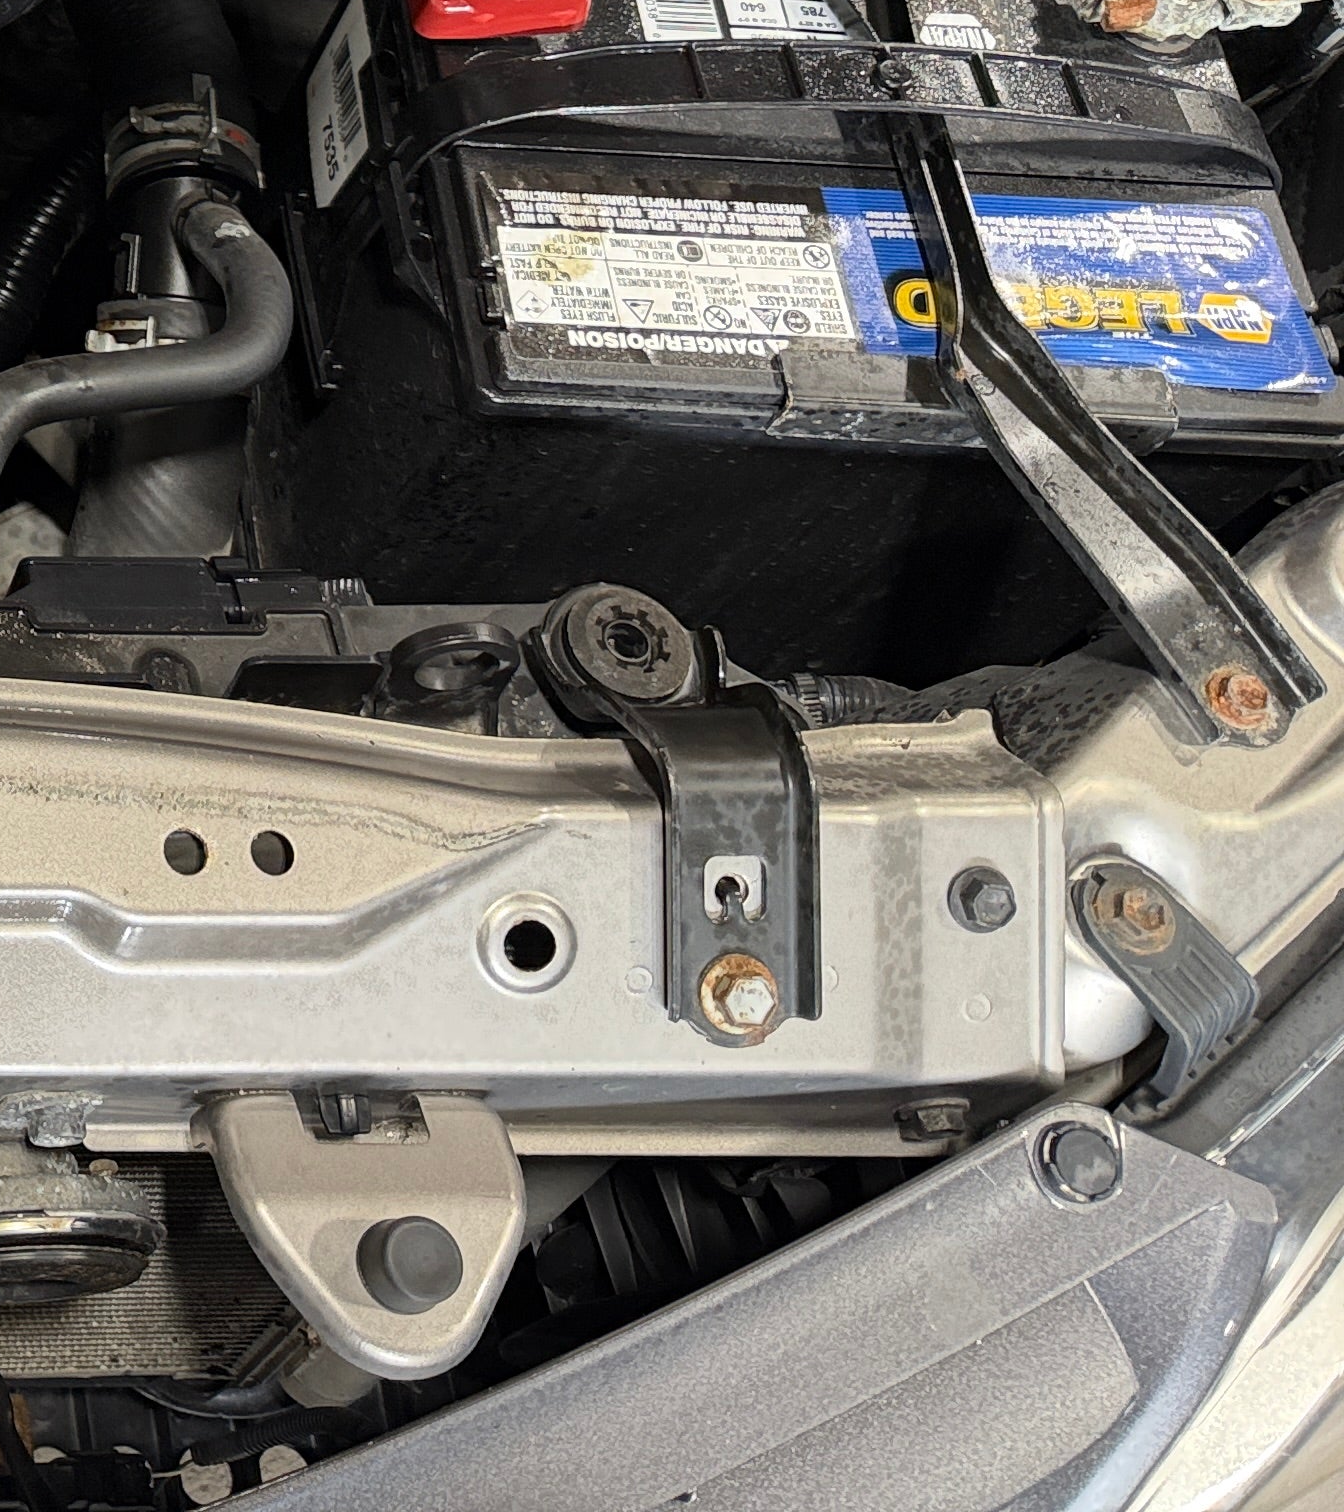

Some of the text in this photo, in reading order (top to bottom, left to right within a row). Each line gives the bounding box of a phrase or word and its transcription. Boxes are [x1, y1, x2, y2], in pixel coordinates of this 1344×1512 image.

[740, 2, 766, 12] 640
[800, 6, 827, 17] 785
[929, 26, 984, 50] NAPA
[322, 114, 339, 181] 7535
[608, 237, 673, 250] INSTRUCTIONS
[632, 250, 675, 261] READ ALL
[757, 295, 840, 309] EXPLOSIVE GASES
[893, 277, 1195, 337] LEGED
[560, 308, 584, 320] EYES
[1112, 331, 1153, 340] THE
[567, 329, 767, 358] DANGER/POISON
